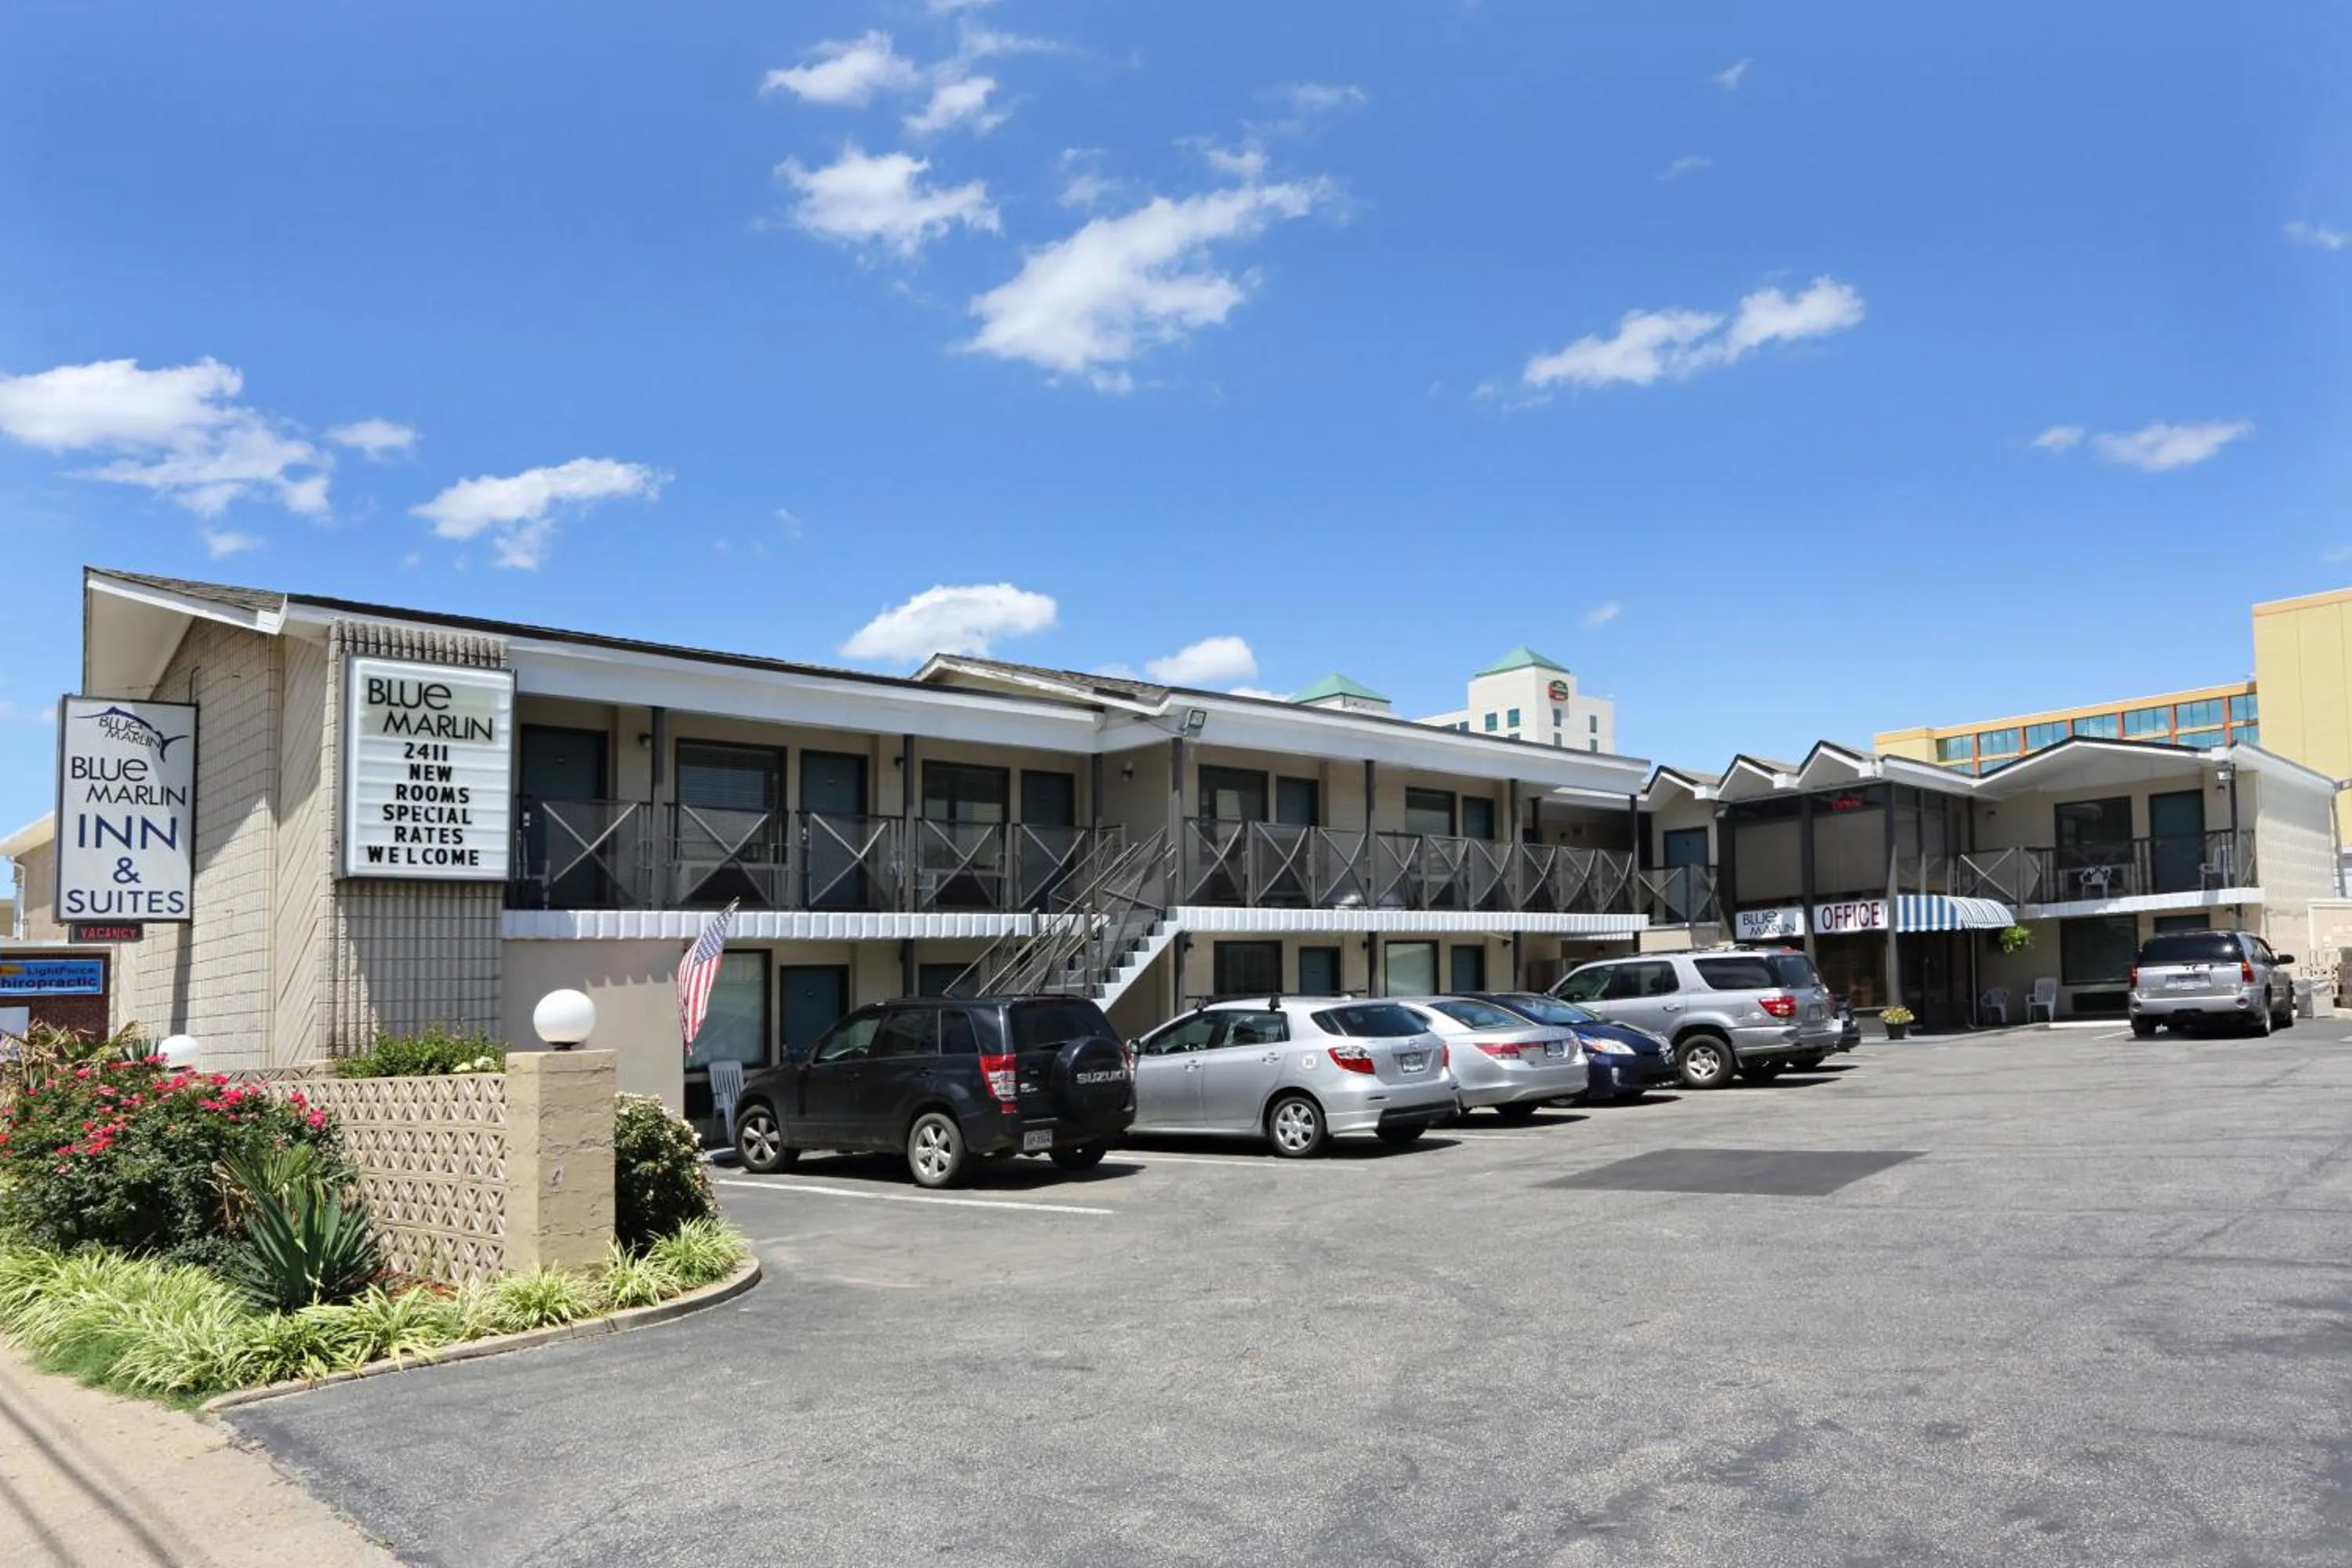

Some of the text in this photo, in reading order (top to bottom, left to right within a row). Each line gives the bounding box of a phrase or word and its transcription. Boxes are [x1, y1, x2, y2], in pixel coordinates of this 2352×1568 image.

[368, 678, 452, 710] BLUe
[383, 710, 493, 741] MARLIN
[104, 729, 161, 749] MARLIN
[404, 742, 448, 761] 2411
[71, 756, 148, 782] BLUe
[408, 763, 452, 782] NEW
[85, 783, 186, 807] MARLIN
[396, 784, 470, 804] ROOMS
[383, 804, 472, 825] SPECIAL
[78, 813, 176, 851] INN
[394, 826, 463, 844] RATES
[367, 846, 479, 866] WELCOME
[112, 856, 143, 884] &
[66, 889, 185, 914] SUITES
[1743, 910, 1777, 926] BLUe
[1821, 902, 1879, 931] OFFICE
[81, 927, 136, 940] VACANCY
[0, 978, 97, 989] hiropractic
[1076, 1069, 1127, 1084] SUZUKI
